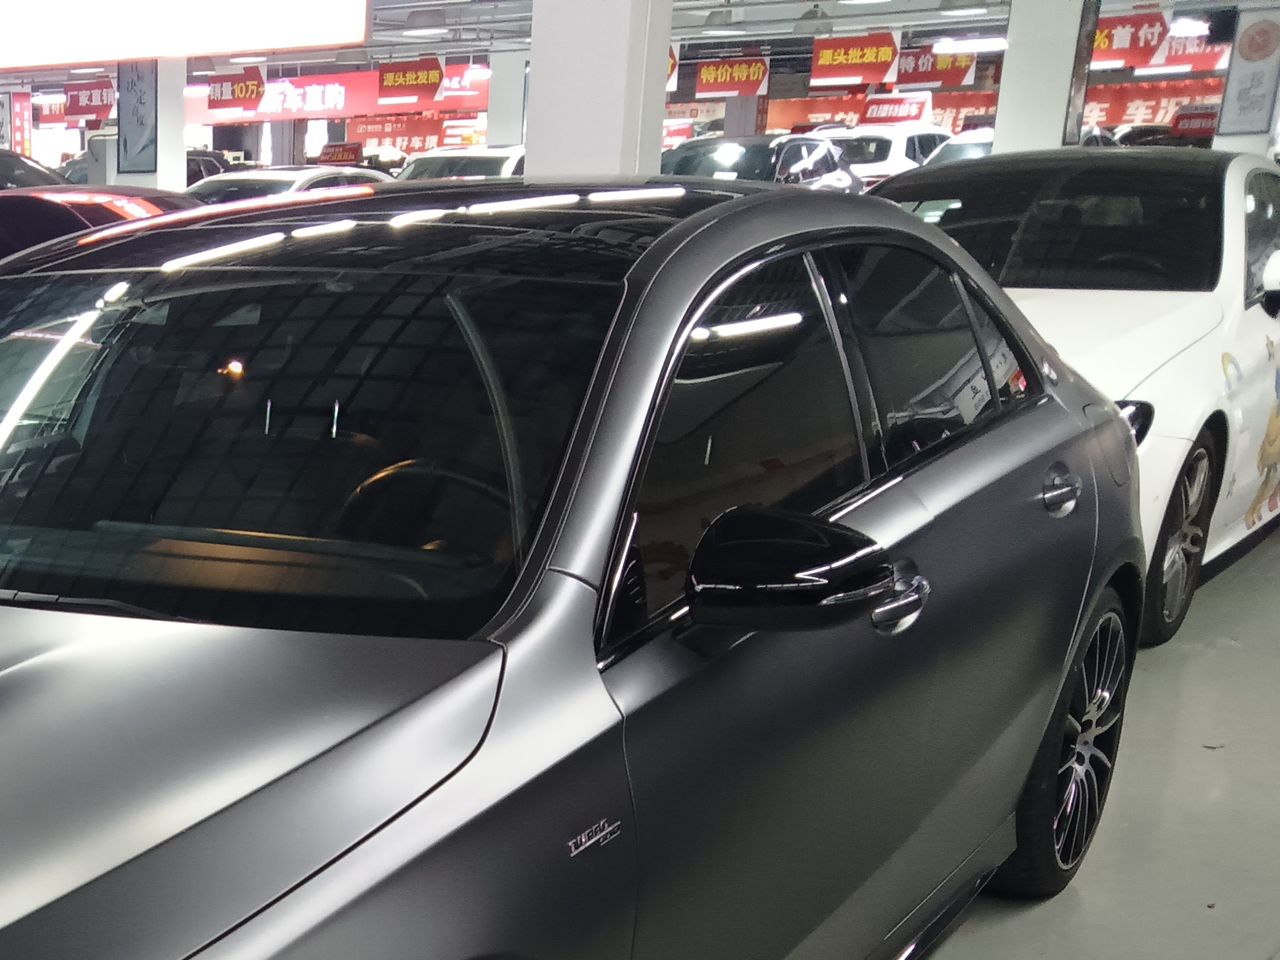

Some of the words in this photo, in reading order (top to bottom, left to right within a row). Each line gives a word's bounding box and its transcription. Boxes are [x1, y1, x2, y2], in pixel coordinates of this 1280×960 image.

[818, 46, 893, 66] 源头批发商
[383, 69, 440, 87] 源头批发商
[700, 62, 765, 84] 特价特价
[66, 88, 116, 107] 厂家直销
